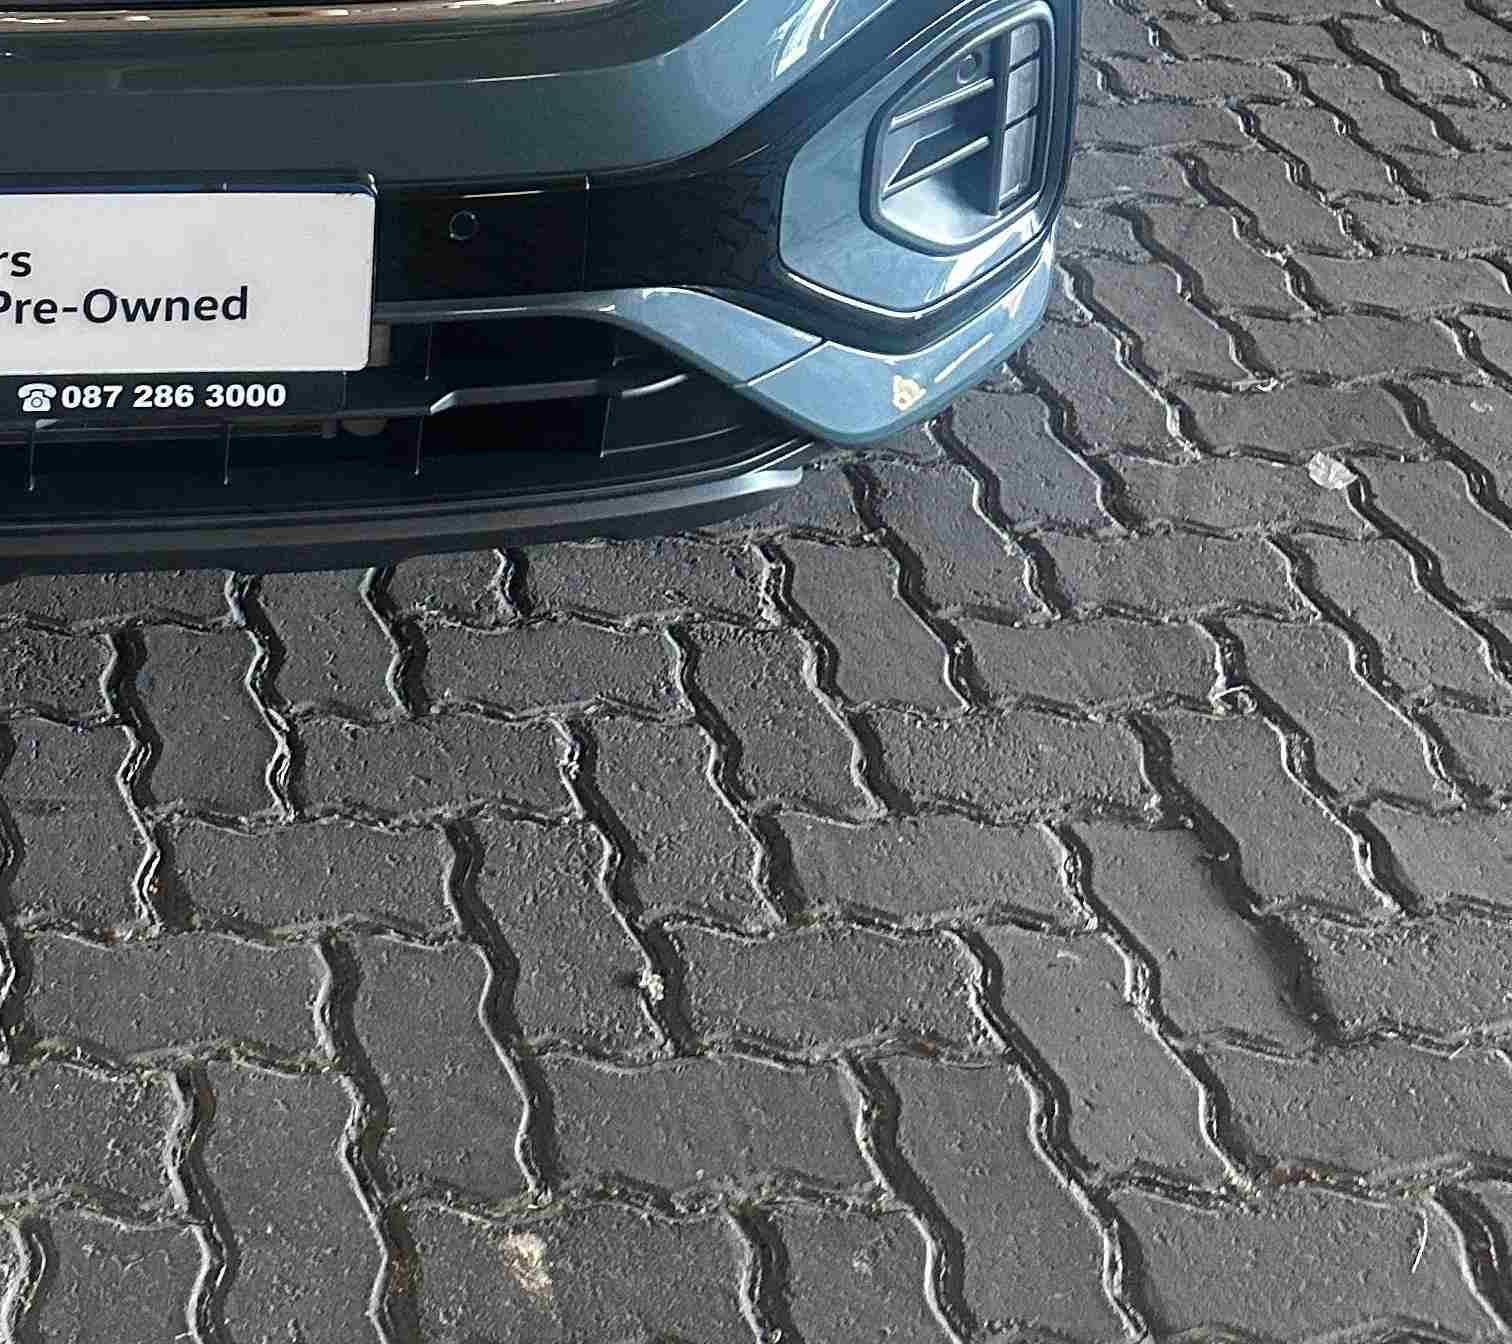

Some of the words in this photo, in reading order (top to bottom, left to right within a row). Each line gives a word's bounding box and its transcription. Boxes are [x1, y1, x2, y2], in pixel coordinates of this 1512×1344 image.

[61, 385, 123, 409] 087
[132, 384, 194, 408] 286
[205, 383, 286, 408] 3000
